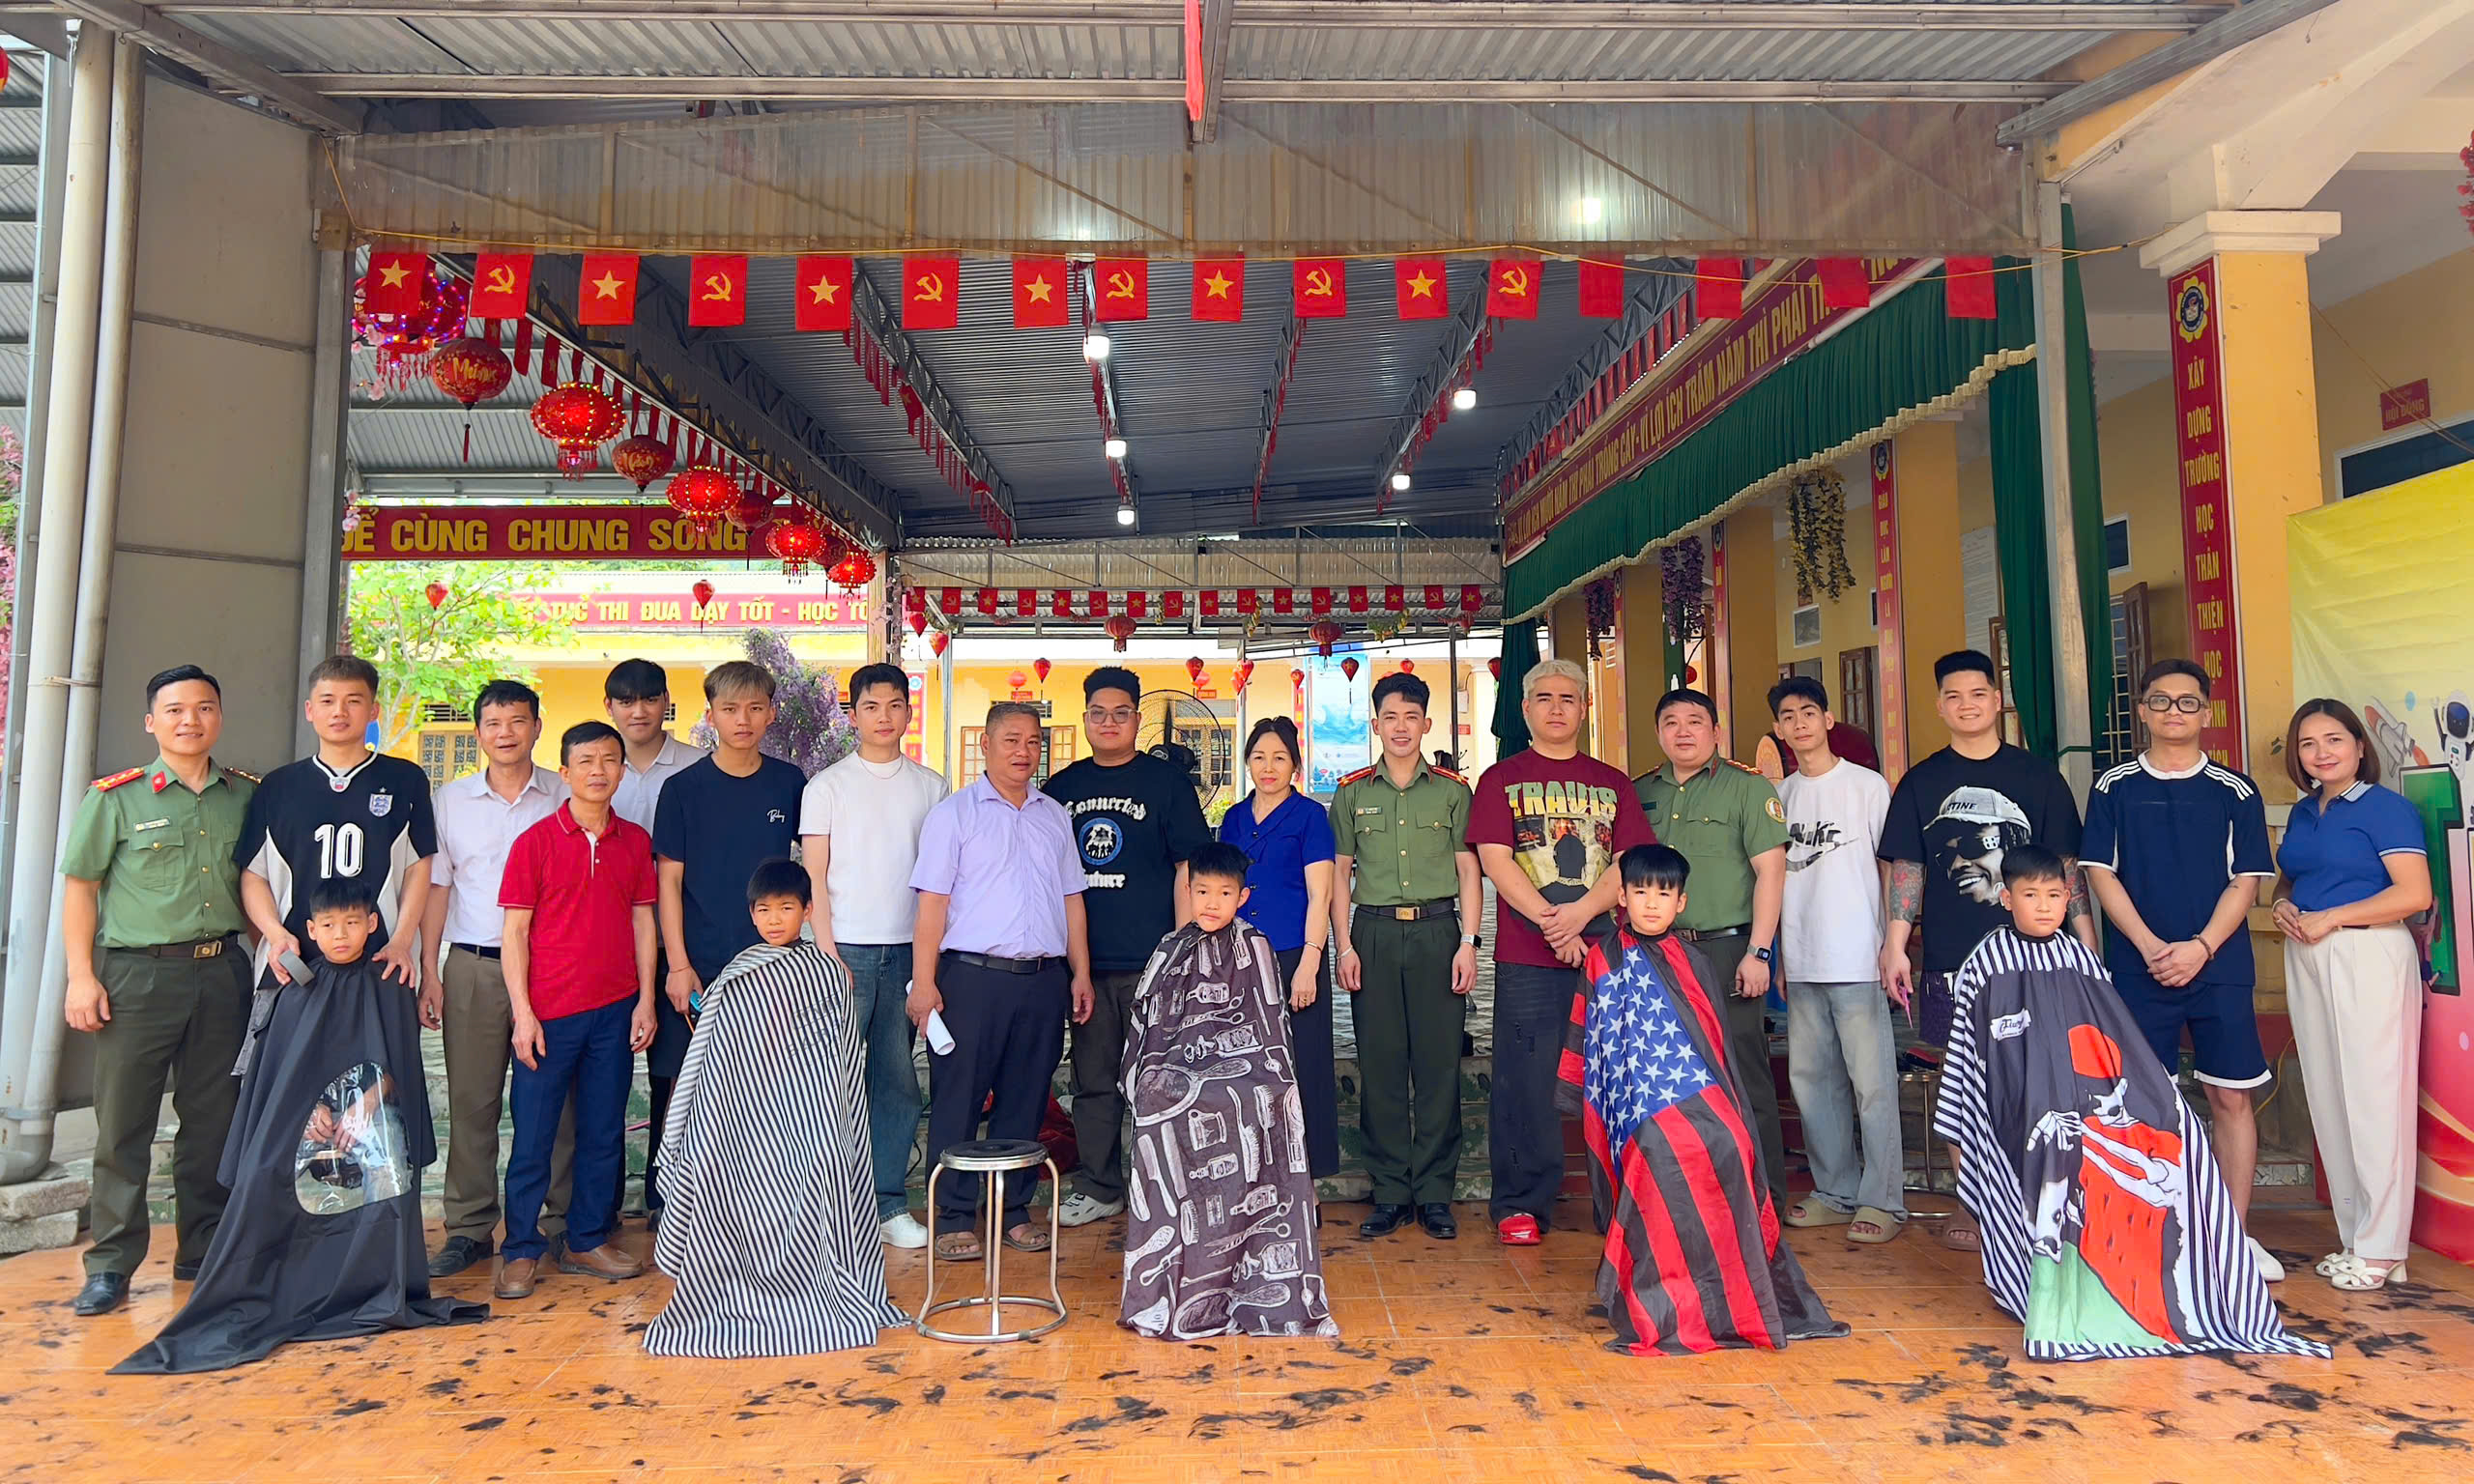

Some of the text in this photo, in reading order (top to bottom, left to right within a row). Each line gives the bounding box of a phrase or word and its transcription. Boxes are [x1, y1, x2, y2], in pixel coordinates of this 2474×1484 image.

[1715, 334, 1745, 396] NĂM
[2187, 355, 2205, 390] XÂY
[2187, 405, 2212, 442] DỰNG
[2184, 449, 2220, 487] TRƯỜNG
[342, 506, 379, 552] Ể
[391, 512, 488, 552] CÙNG
[507, 519, 629, 552] CHUNG
[2196, 502, 2215, 539] HỌC
[2195, 546, 2220, 582] THÂN
[597, 601, 629, 621] THI
[641, 601, 681, 621] ĐUA
[737, 595, 774, 621] TỐT
[797, 601, 839, 626] HỌC
[2197, 595, 2225, 635] THIỆN
[2203, 650, 2224, 685] HỌC
[2210, 699, 2228, 728] INH
[1504, 781, 1618, 820] TRAVIS
[314, 822, 364, 879] 10
